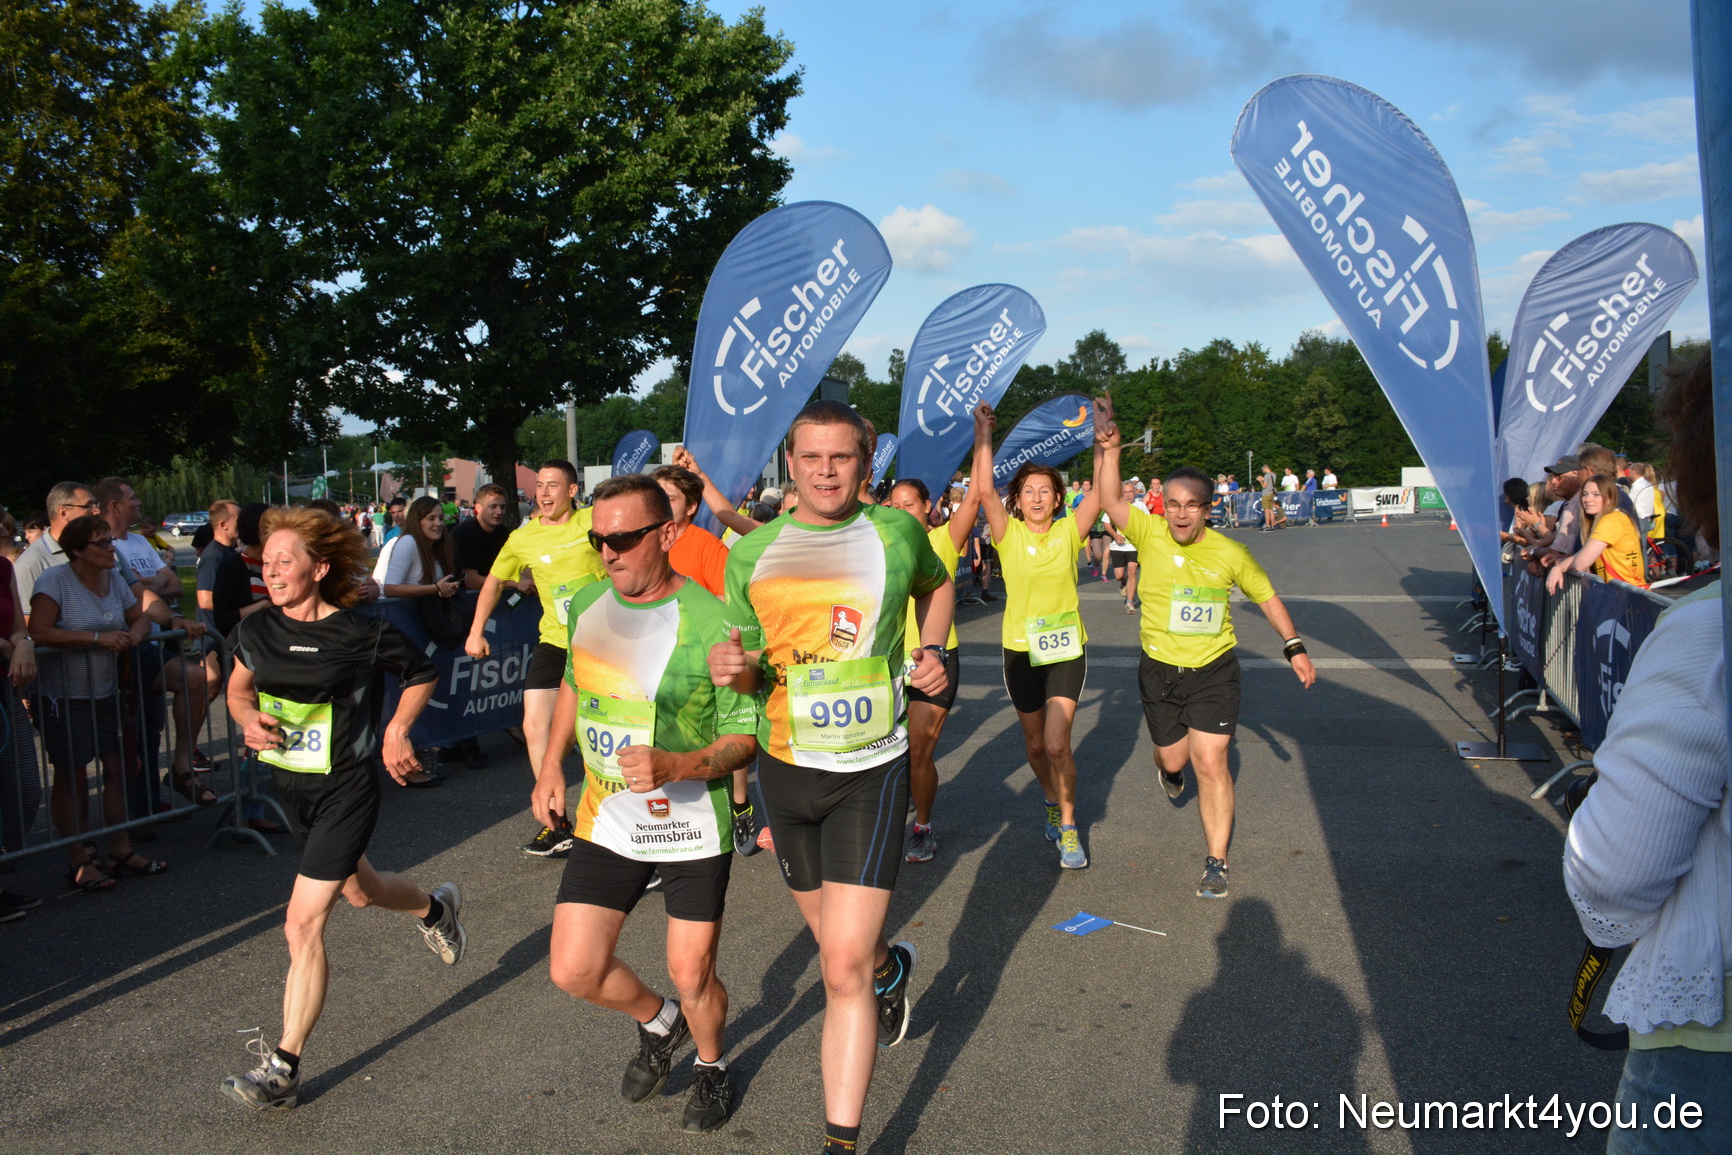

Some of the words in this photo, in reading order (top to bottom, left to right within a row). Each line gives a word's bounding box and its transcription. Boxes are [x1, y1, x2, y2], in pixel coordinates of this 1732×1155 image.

[739, 238, 849, 390] Fischer
[778, 268, 861, 389] AUTOMOBILE
[1550, 252, 1654, 390] Fischer
[1586, 277, 1667, 387] AUTOMOBILE
[935, 307, 1013, 417] Fischer
[964, 327, 1023, 416] AUTOMOBILE
[622, 437, 649, 474] Fischer
[874, 439, 893, 469] Fischer
[993, 428, 1072, 479] Frischmann
[1043, 443, 1063, 458] Druck
[1075, 424, 1095, 441] Medie
[1180, 606, 1213, 622] 621
[835, 640, 849, 648] 1628
[1039, 631, 1070, 650] 635
[449, 643, 534, 695] Fisch
[463, 689, 524, 717] AUTOM
[810, 696, 872, 728] 990
[842, 730, 866, 739] Schober
[631, 829, 702, 844] Lammsbräu
[636, 821, 690, 831] Neumarkter
[1576, 954, 1600, 999] Nikon
